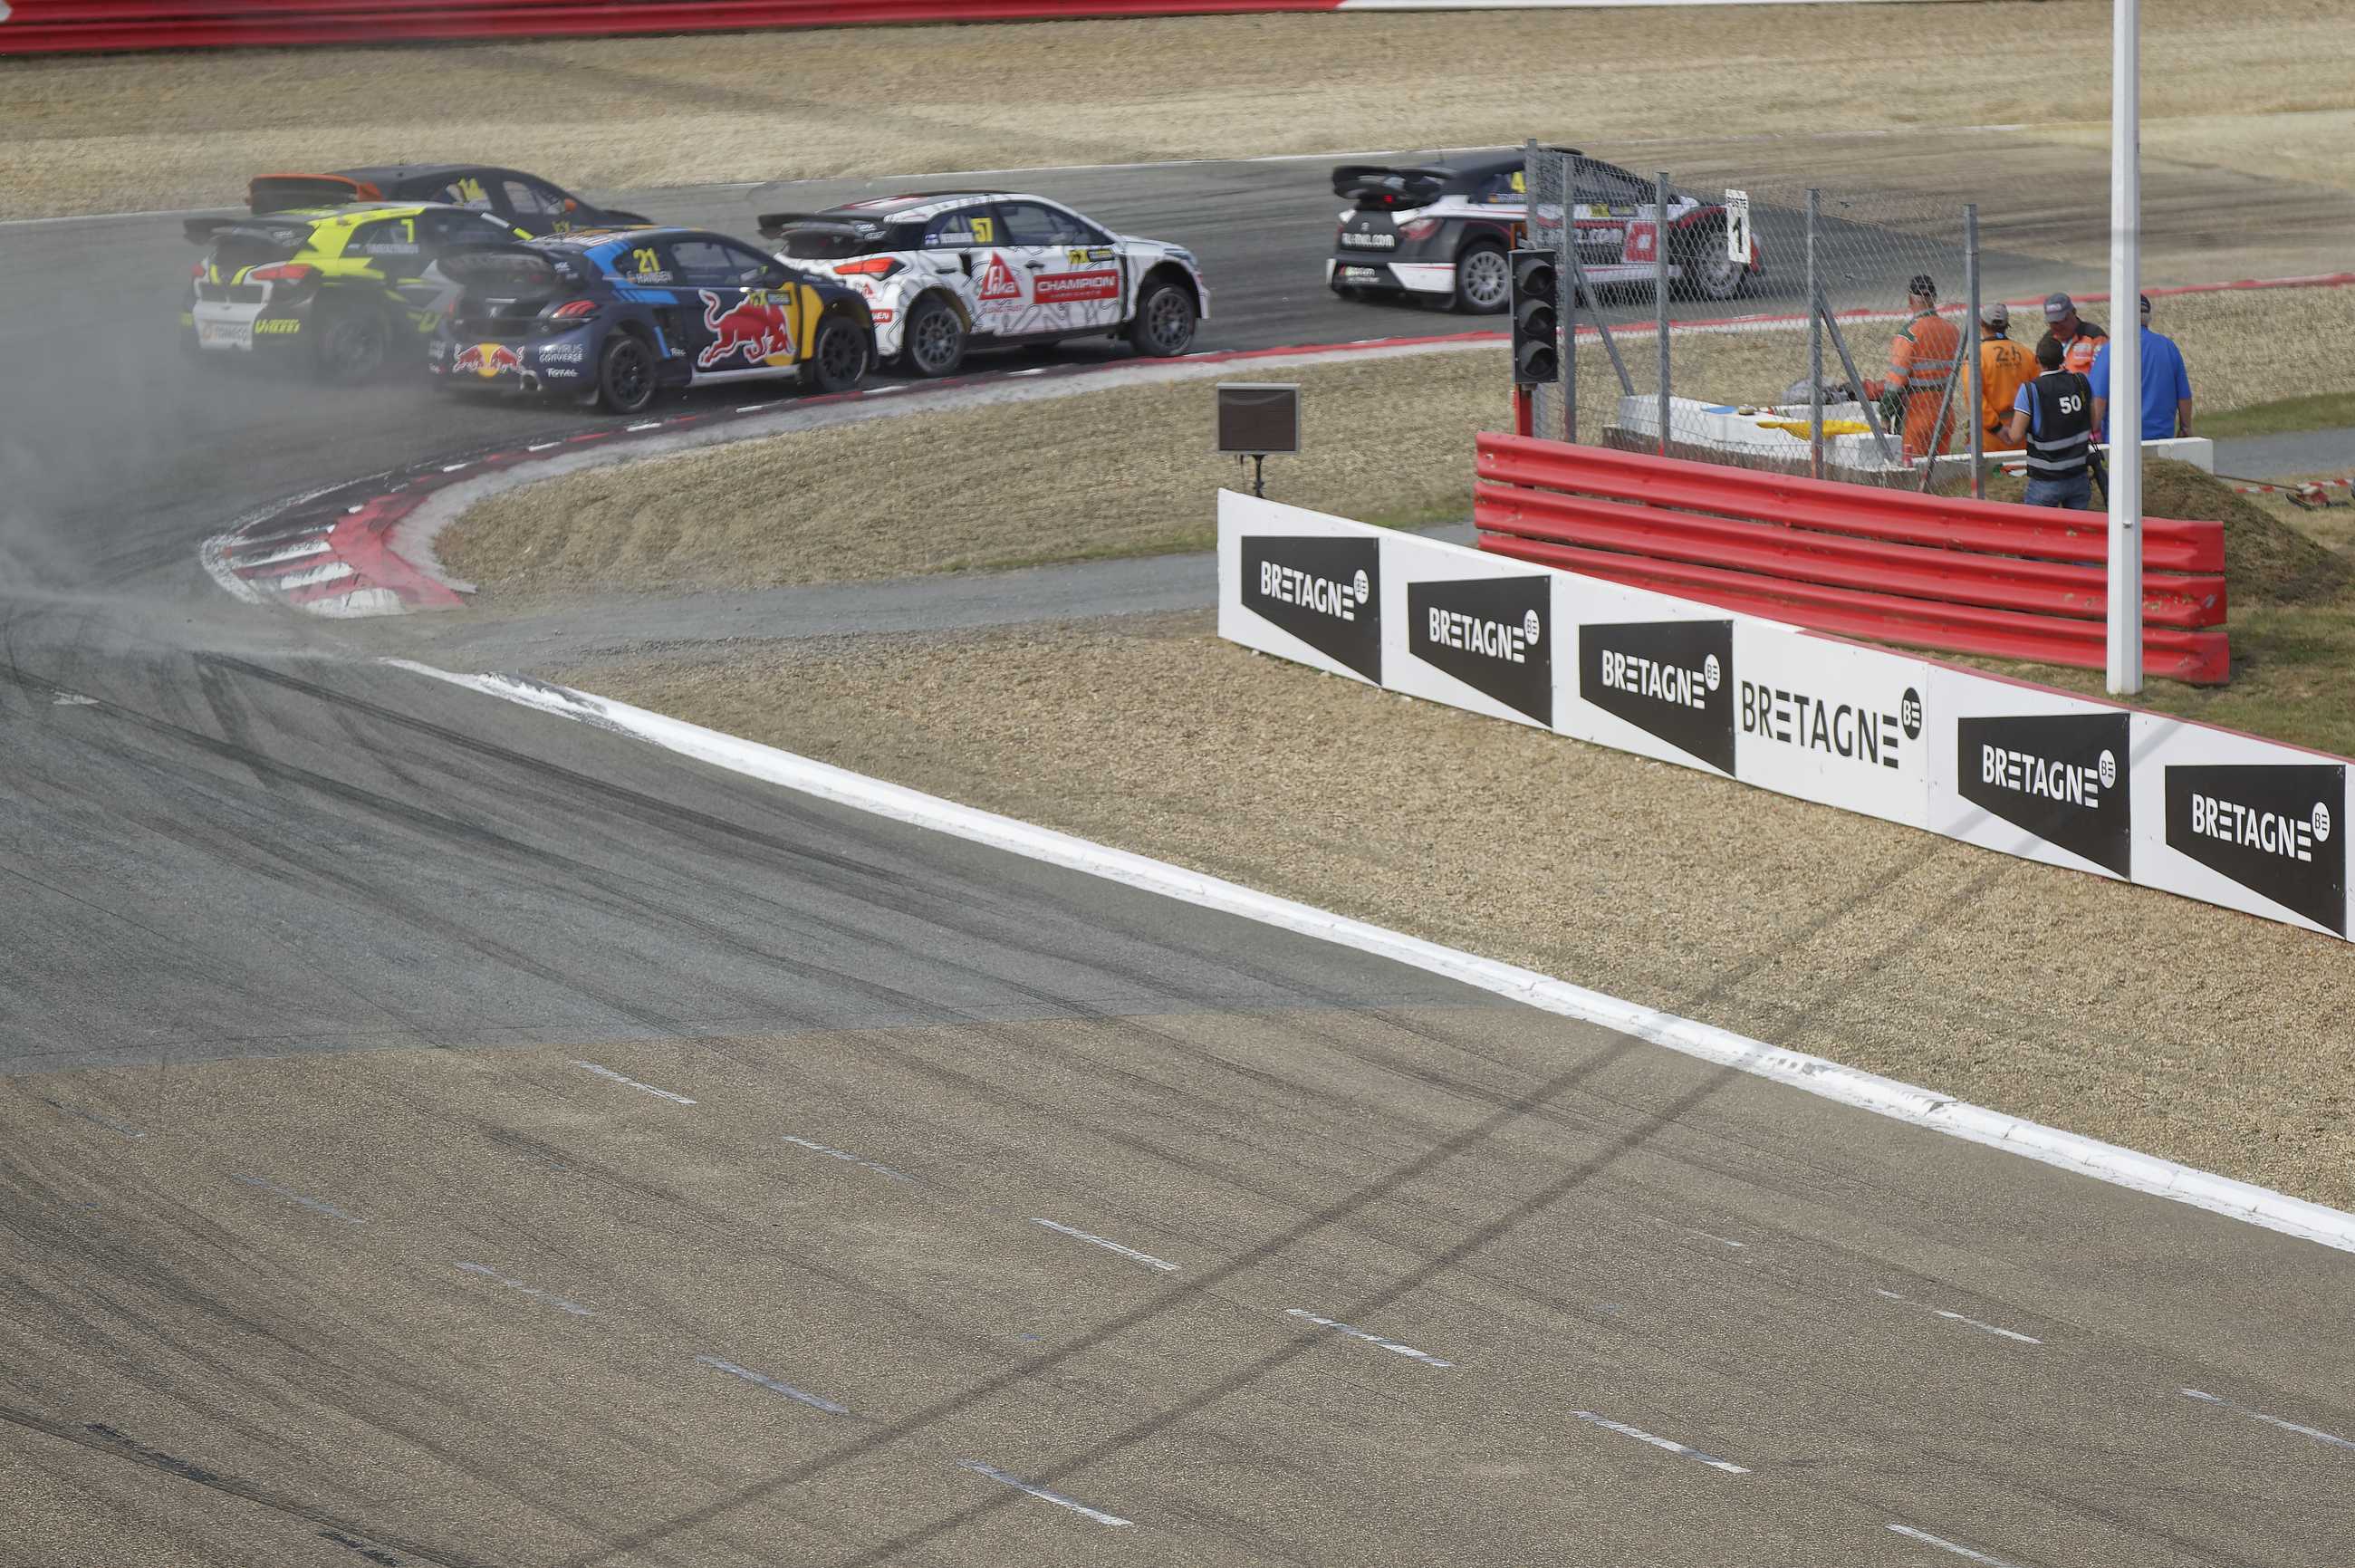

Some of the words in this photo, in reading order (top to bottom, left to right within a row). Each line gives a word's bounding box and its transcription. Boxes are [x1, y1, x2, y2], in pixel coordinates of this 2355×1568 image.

[971, 217, 994, 243] 57
[1732, 216, 1743, 254] 1
[632, 247, 661, 274] 21
[1036, 275, 1117, 293] CHAMPION
[2059, 394, 2082, 415] 50
[1261, 562, 1354, 621] BRETAGNE
[1429, 608, 1525, 663] BRETAGNE
[1602, 650, 1705, 709] BRETAGNE
[1743, 681, 1898, 769] BRETAGNE
[1984, 745, 2099, 808] BRETAGNE
[2193, 794, 2312, 862] BRETAGNE
